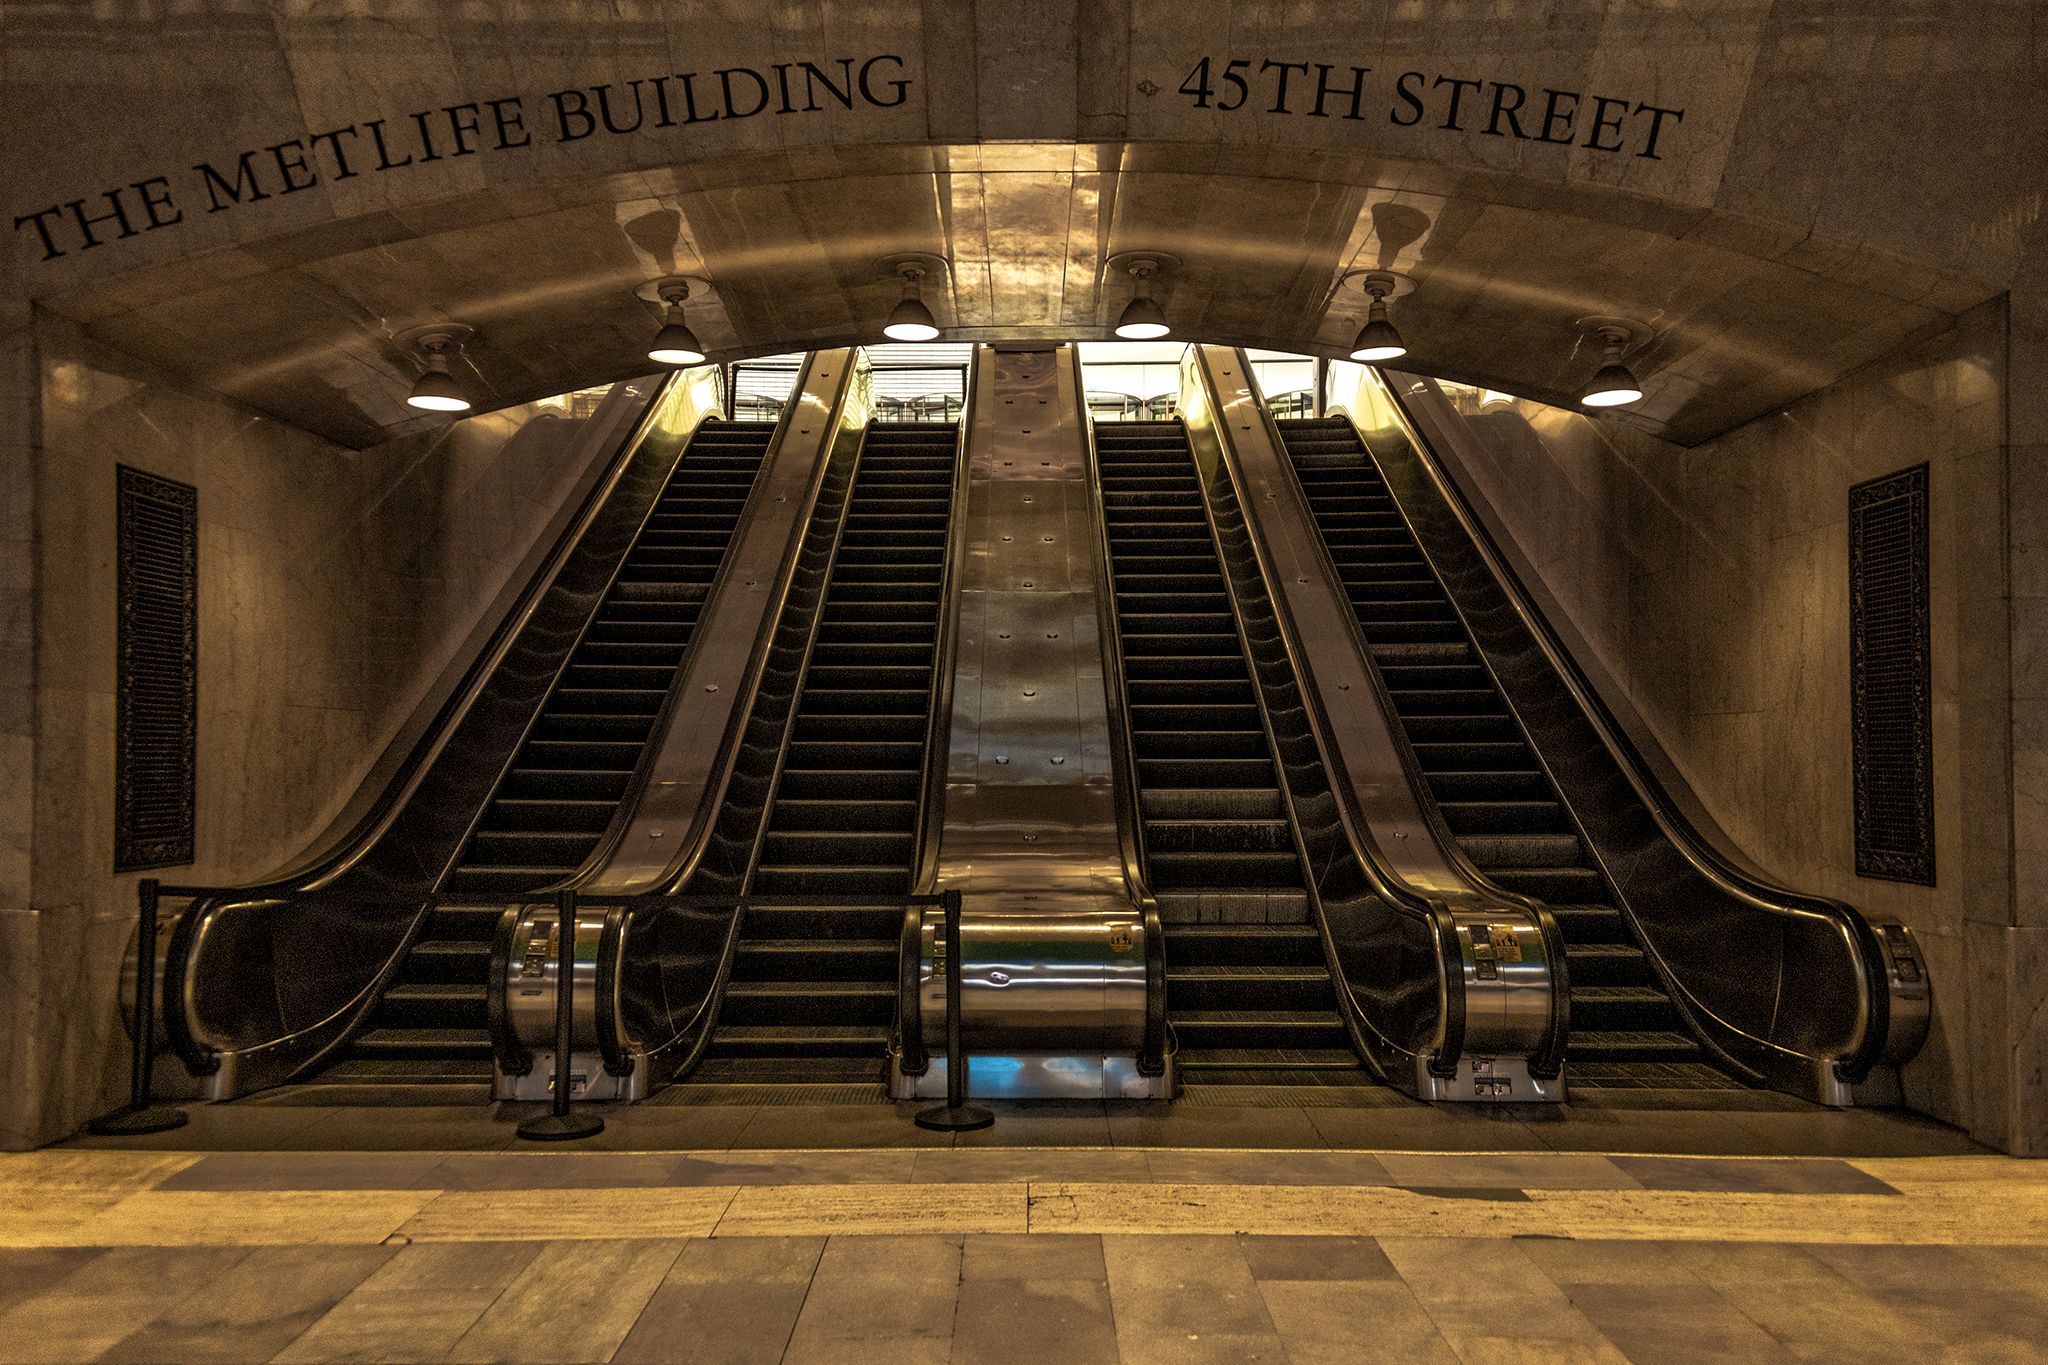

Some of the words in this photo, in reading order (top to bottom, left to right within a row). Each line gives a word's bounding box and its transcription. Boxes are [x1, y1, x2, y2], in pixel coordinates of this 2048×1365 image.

[13, 176, 184, 262] THE
[191, 95, 532, 215] METLIFE
[546, 54, 913, 144] BUILDING
[1178, 55, 1372, 122] 45TH
[1389, 70, 1685, 161] STREET
